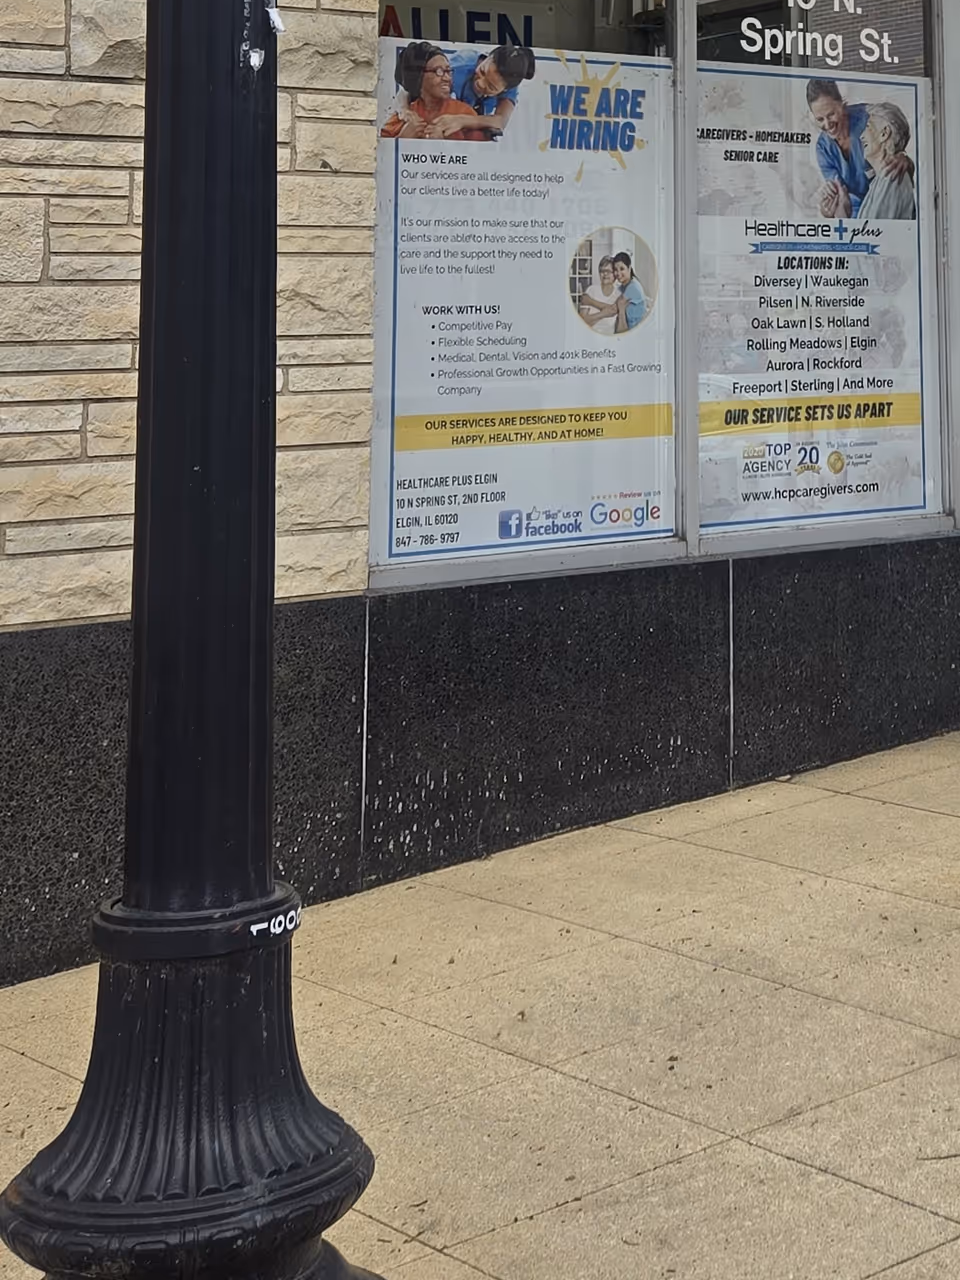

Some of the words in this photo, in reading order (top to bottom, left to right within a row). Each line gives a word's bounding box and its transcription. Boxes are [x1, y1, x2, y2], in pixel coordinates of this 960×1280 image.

[740, 17, 843, 65] Spring
[859, 28, 899, 63] St.
[550, 84, 590, 116] WE
[595, 88, 646, 119] ARE
[550, 118, 636, 152] HIRING
[697, 128, 747, 140] AREGIVERS
[755, 131, 811, 144] HOMEMAKERS
[402, 154, 427, 164] WHO
[429, 154, 446, 164] WE
[448, 156, 467, 164] ARE
[724, 150, 754, 162] SENIOR
[757, 152, 779, 163] CARE
[401, 169, 418, 179] Our
[421, 171, 458, 180] services
[477, 172, 489, 181] all
[491, 173, 531, 184] designed
[534, 174, 543, 182] to
[545, 174, 564, 184] help
[401, 186, 417, 194] our
[419, 186, 450, 196] clients
[452, 186, 468, 196] live
[478, 186, 504, 197] better
[507, 187, 521, 197] life
[523, 189, 549, 199] today!
[745, 220, 831, 237] Healthcare
[849, 220, 883, 244] plus
[400, 265, 416, 274] live
[419, 265, 433, 274] life
[436, 266, 445, 274] to
[448, 266, 462, 274] the
[465, 265, 495, 274] fullest!
[778, 257, 833, 270] LOCATIONS
[835, 257, 849, 269] IN:
[754, 276, 802, 289] Diversey
[810, 276, 868, 289] Waukegan
[759, 297, 792, 308] Pilsen
[801, 298, 812, 307] N.
[816, 296, 865, 307] Riverside
[422, 306, 453, 315] WORK
[456, 306, 482, 314] WITH
[484, 305, 500, 314] US!
[438, 322, 494, 331] Competitive
[495, 321, 513, 332] Pay
[752, 318, 773, 329] Oak
[777, 318, 806, 328] Lawn
[815, 317, 825, 328] S.
[828, 316, 869, 328] Holland
[438, 338, 474, 347] Flexible
[477, 337, 527, 347] Scheduling
[747, 339, 787, 352] Rolling
[790, 338, 842, 349] Meadows
[851, 337, 877, 350] Elgin
[513, 352, 539, 360] Vision
[541, 351, 557, 360] and
[559, 351, 580, 360] 401k
[581, 349, 616, 359] Benefits
[438, 369, 494, 379] Professional
[496, 368, 528, 377] Growth
[530, 366, 589, 377] Opportunities
[608, 364, 625, 373] Fast
[627, 363, 661, 373] Growing
[766, 360, 804, 372] Aurora
[813, 358, 862, 370] Rockford
[437, 386, 482, 396] Company
[733, 382, 782, 396] Freeport
[791, 380, 834, 393] Sterling
[843, 378, 864, 389] And
[867, 378, 893, 388] More
[425, 420, 447, 430] OUR
[450, 419, 496, 429] SERVICES
[498, 417, 517, 426] ARE
[519, 415, 566, 425] DESIGNED
[569, 415, 581, 423] TO
[583, 413, 606, 422] KEEP
[607, 411, 627, 421] YOU
[725, 409, 749, 425] OUR
[752, 406, 801, 424] SERVICE
[805, 405, 834, 421] SETS
[837, 404, 851, 419] US
[854, 402, 893, 419] APART
[452, 435, 487, 445] HAPPY,
[489, 433, 535, 443] HEALTHY,
[537, 431, 558, 440] AND
[560, 430, 572, 439] AT
[574, 428, 603, 437] HOME!
[766, 443, 791, 456] TOP
[798, 447, 819, 464] 20
[742, 459, 791, 473] AGENCY
[397, 477, 450, 490] HEALTHCARE
[452, 475, 473, 486] PLUS
[475, 474, 497, 484] ELGIN
[742, 482, 879, 502] www.hcpcaregivers.com
[396, 498, 406, 510] 10
[407, 498, 414, 508] N
[416, 496, 445, 507] SPRING
[448, 495, 460, 506] ST,
[462, 493, 479, 505] 2ND
[481, 491, 506, 503] FLOOR
[396, 517, 422, 528] ELGIN,
[424, 516, 433, 526] IL
[435, 514, 458, 525] 60120
[590, 500, 660, 527] Google
[525, 520, 582, 537] facebook
[396, 536, 411, 548] 847
[440, 533, 460, 543] 9797
